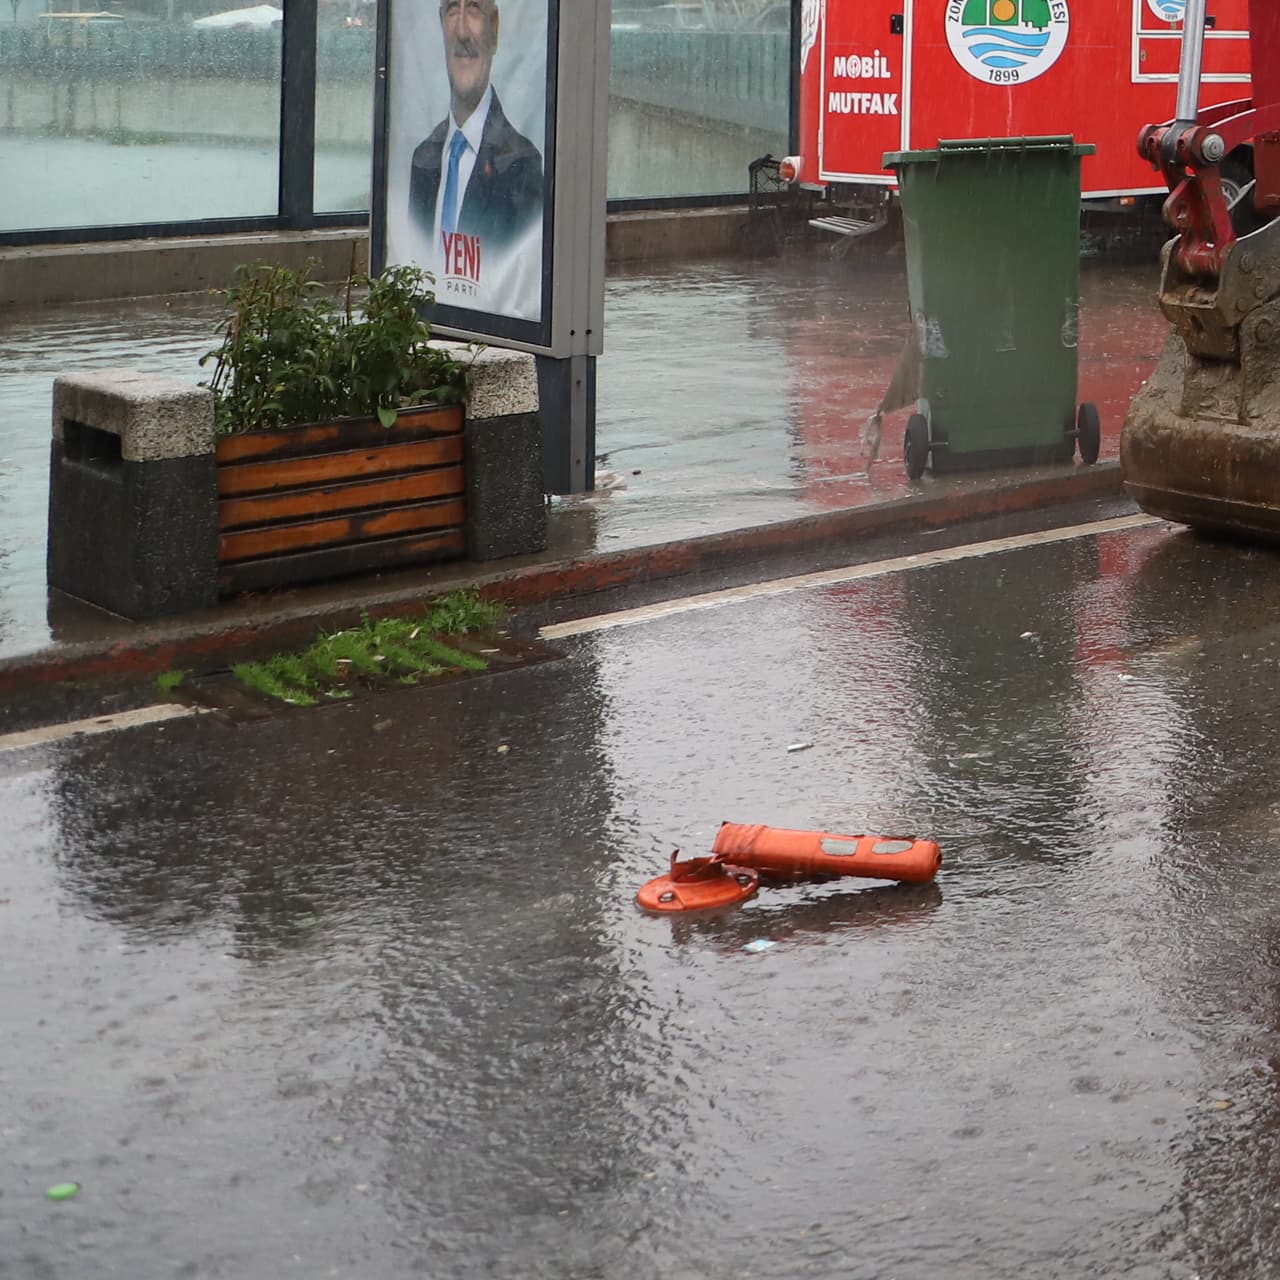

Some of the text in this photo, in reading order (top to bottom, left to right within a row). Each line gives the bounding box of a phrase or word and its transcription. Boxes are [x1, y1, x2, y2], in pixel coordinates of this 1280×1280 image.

[833, 49, 891, 79] MOBİL
[988, 68, 1020, 82] 1899
[828, 92, 899, 116] MUTFAK
[441, 230, 481, 282] YENİ
